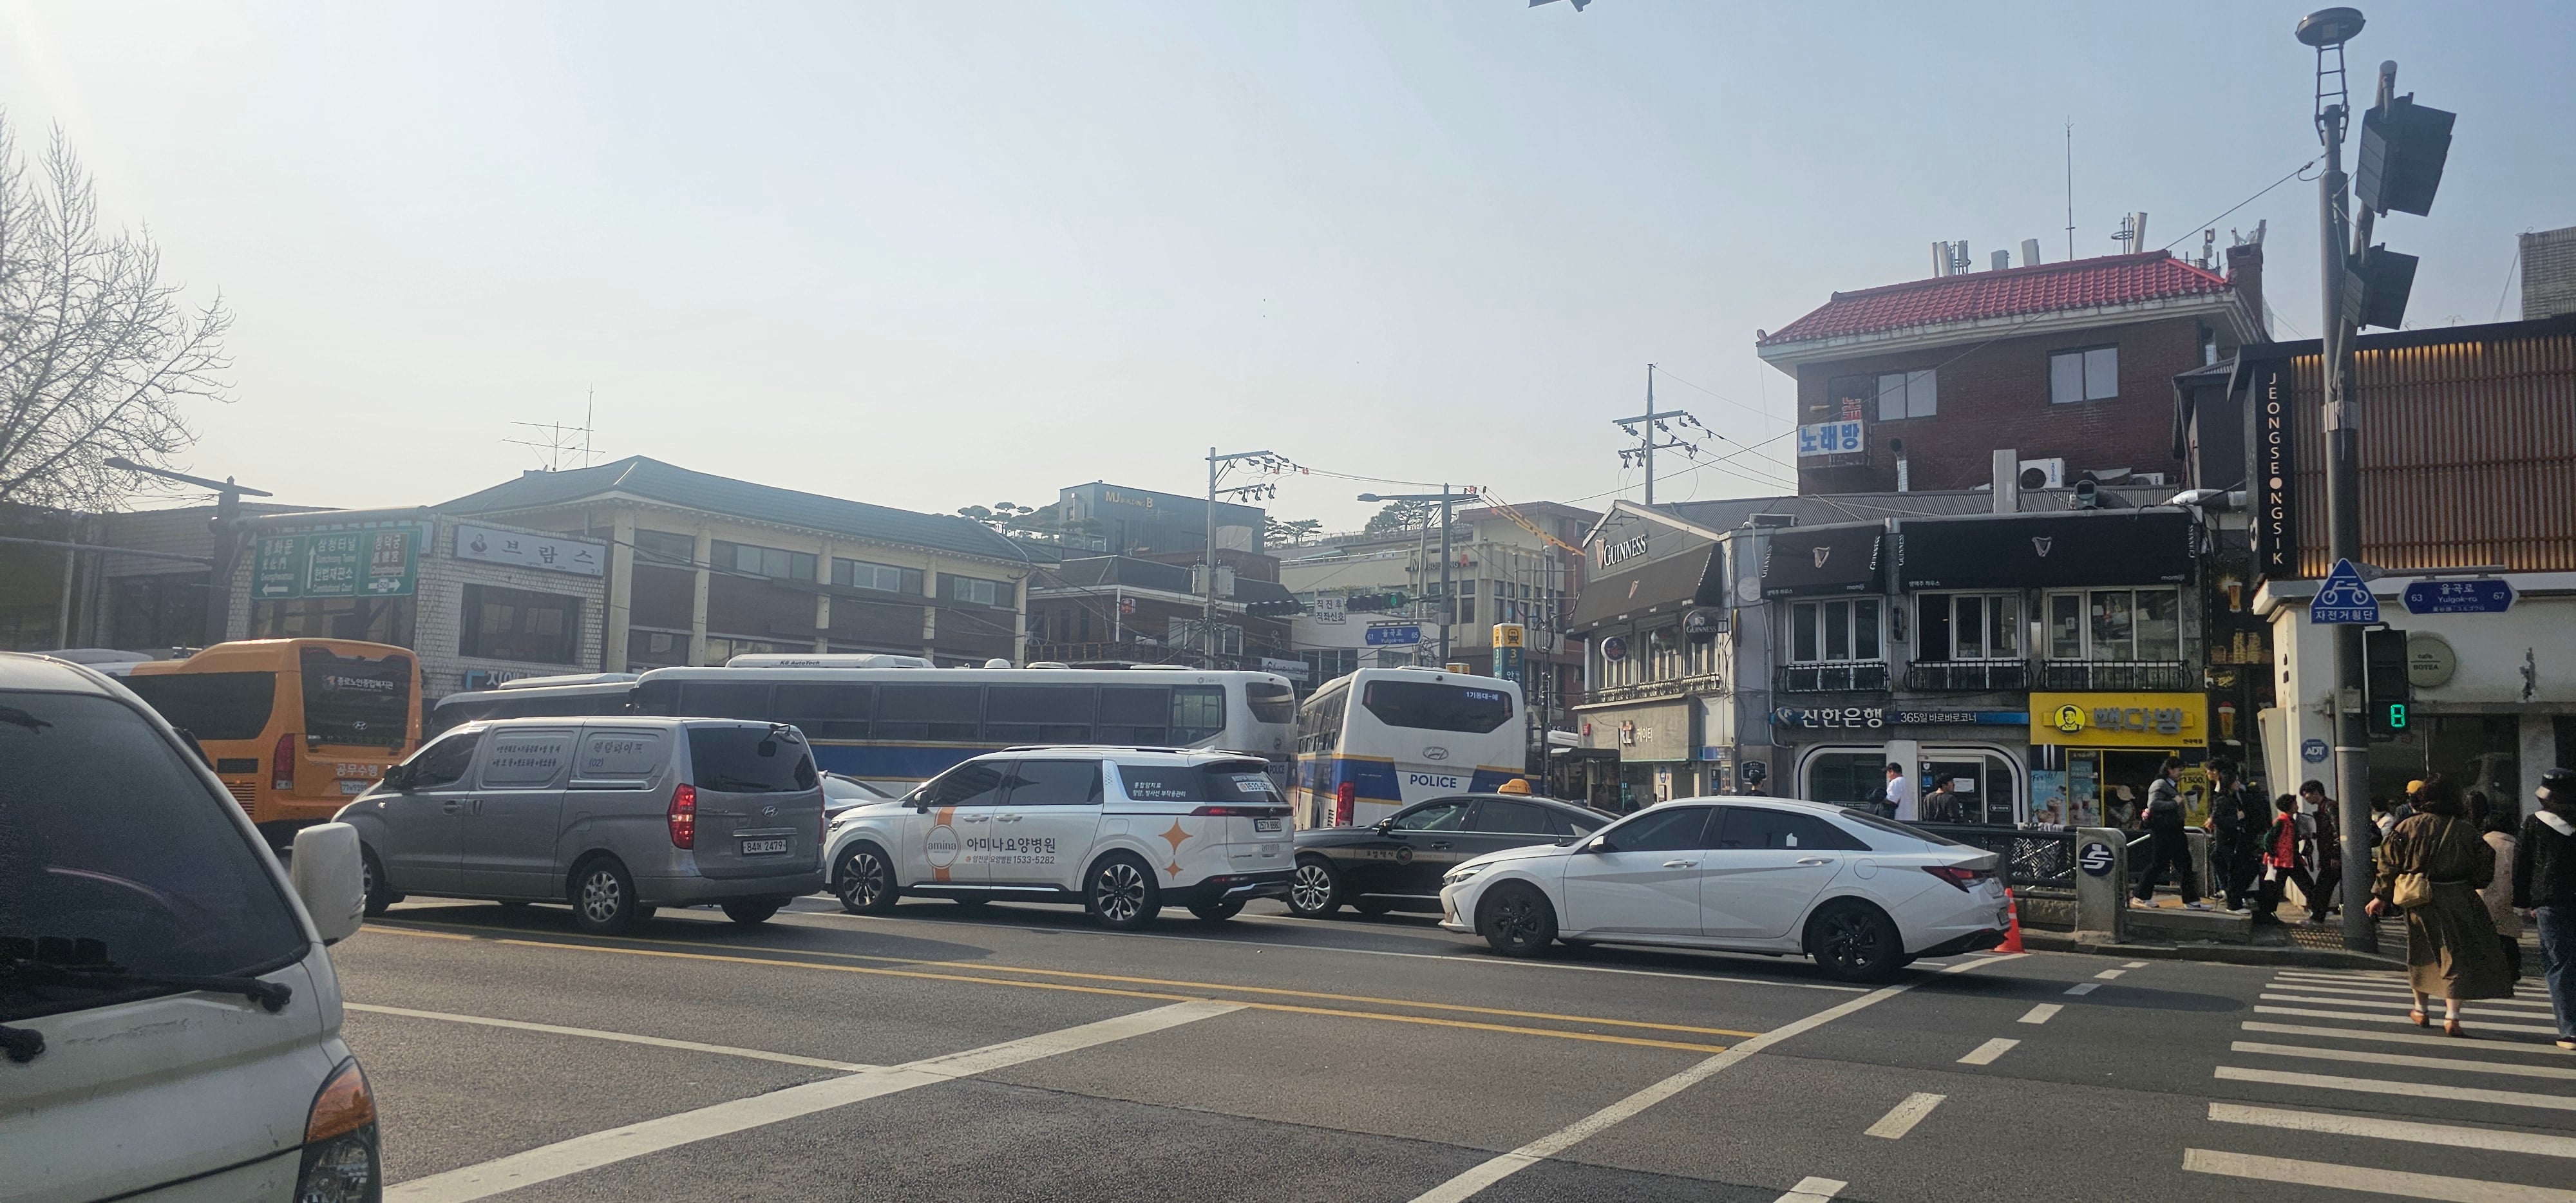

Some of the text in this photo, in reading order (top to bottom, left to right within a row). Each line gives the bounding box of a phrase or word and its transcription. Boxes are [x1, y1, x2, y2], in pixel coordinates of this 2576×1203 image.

[1801, 423, 1860, 453] 노래방
[1105, 491, 1120, 502] MJ
[1146, 497, 1153, 507] B
[317, 536, 356, 552] 삼청터널
[375, 534, 401, 550] 창덕궁
[502, 539, 594, 565] 브람스
[1604, 535, 1647, 566] GUINNESS
[1460, 553, 1470, 567] A
[314, 567, 354, 582] 헌법재판소
[2439, 583, 2475, 594] 율곡로
[2410, 594, 2423, 602] 63
[2438, 596, 2478, 604] Yulgok-ro
[2493, 592, 2505, 600] 67
[1316, 612, 1345, 622] 직좌신호
[2315, 611, 2373, 621] 자전거횡단
[1686, 625, 1717, 634] GUINNESS
[1510, 649, 1517, 658] 3
[1801, 708, 1883, 728] 신한은행
[1900, 712, 1977, 723] 365일 바로바로코너
[2094, 706, 2184, 734] 빽다방
[2390, 704, 2405, 728] 8
[1636, 727, 1653, 743] 케이티
[2304, 746, 2324, 755] ADT
[336, 763, 379, 777] 공무수행
[1269, 764, 1285, 773] POLICE
[1410, 774, 1457, 788] POLICE
[765, 841, 782, 851] 2479
[927, 840, 956, 851] amina
[967, 837, 1056, 853] 아미나요양병원
[1262, 843, 1280, 852] amina
[1013, 855, 1055, 864] 1533-5282
